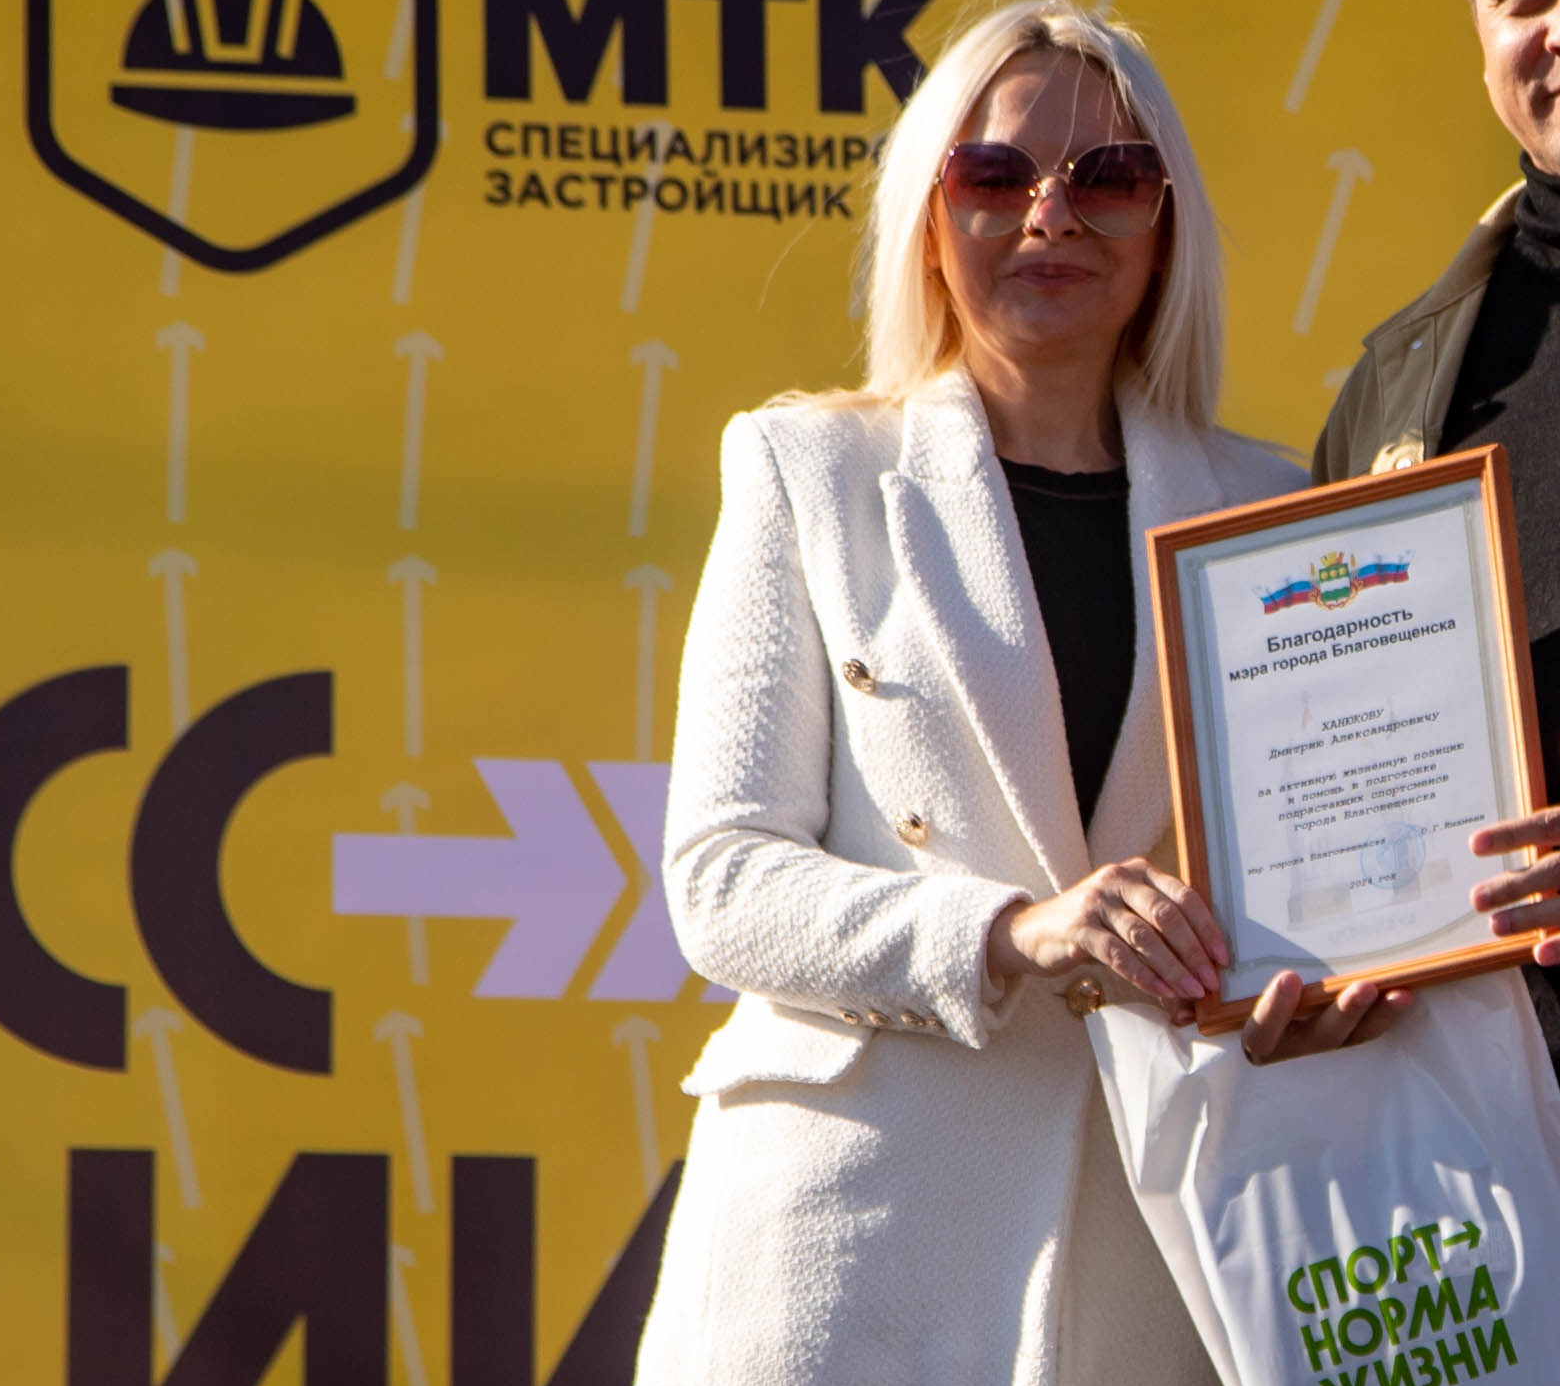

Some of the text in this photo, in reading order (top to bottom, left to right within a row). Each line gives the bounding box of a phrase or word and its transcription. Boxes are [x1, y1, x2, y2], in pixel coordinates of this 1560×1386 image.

[485, 121, 886, 170] СПЕЦИАЛИЗИР
[485, 169, 853, 222] ЗАСТРОЙЩИК
[1229, 618, 1457, 682] мэра города Благовещенска
[1267, 608, 1414, 654] Благодарность
[1268, 711, 1440, 760] Дмитрию Александровичу
[1413, 741, 1465, 762] позицию
[1365, 762, 1437, 788] подготовке
[1371, 773, 1449, 800] спортсменов
[1294, 815, 1337, 832] города
[1288, 1223, 1439, 1314] СПОРТ
[1301, 1264, 1500, 1373] НОРМА
